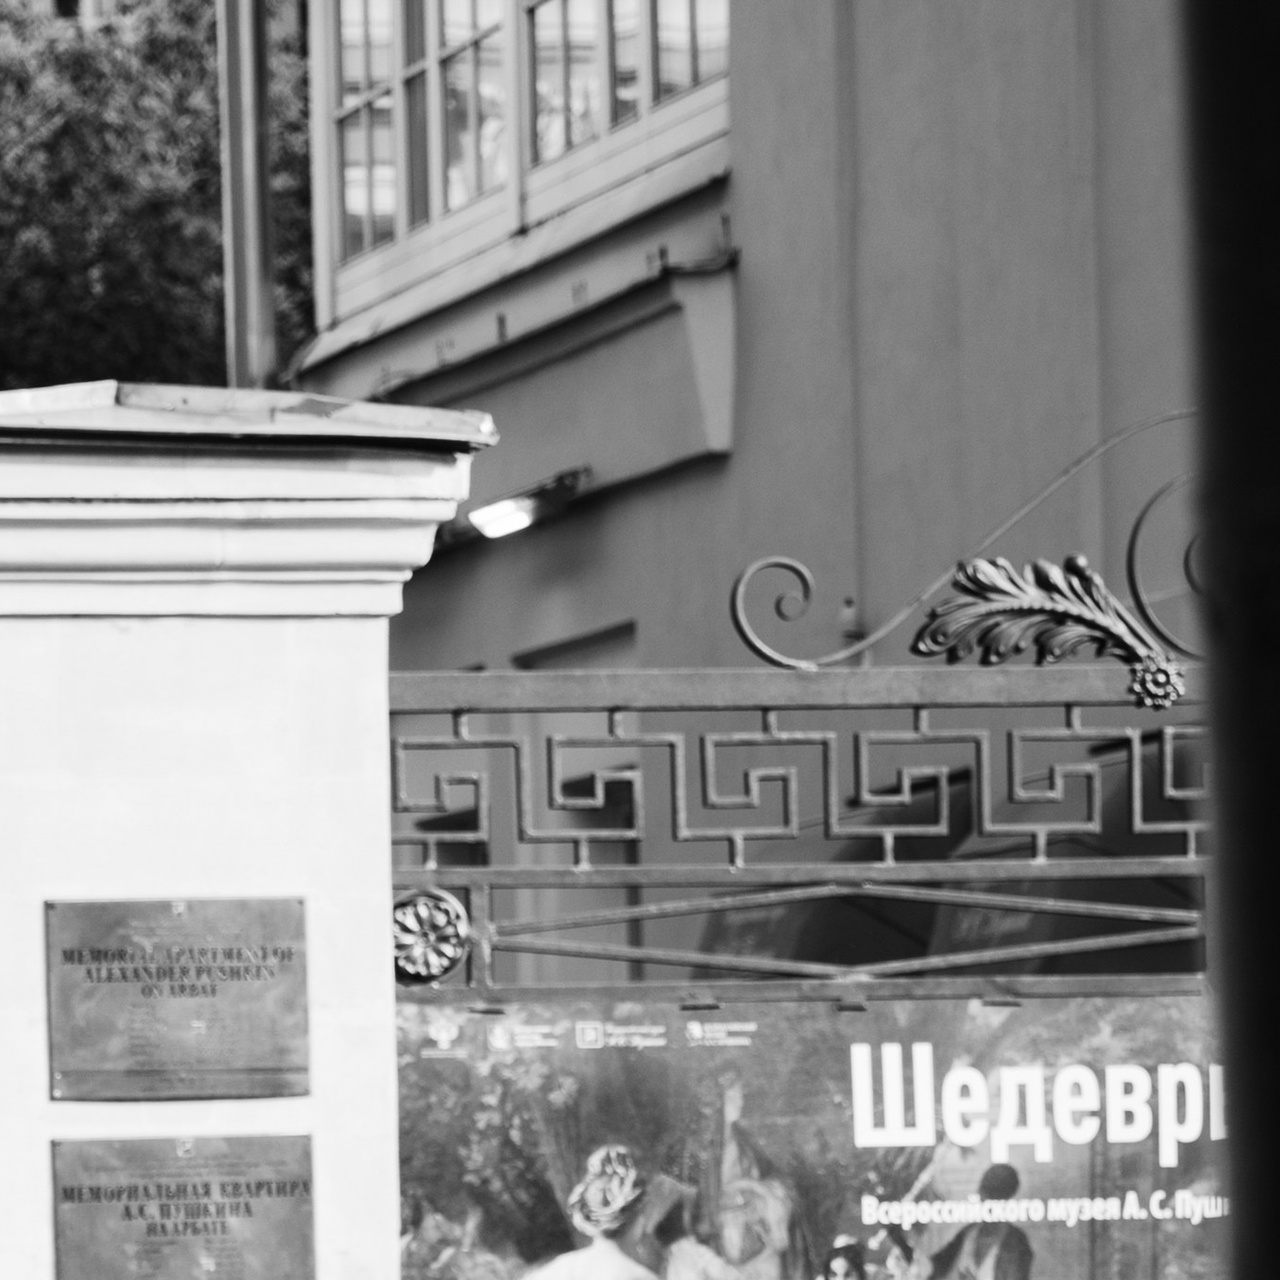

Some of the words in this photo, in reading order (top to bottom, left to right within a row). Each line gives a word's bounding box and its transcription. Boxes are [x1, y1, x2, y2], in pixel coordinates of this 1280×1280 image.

[861, 1194, 1045, 1230] Всероссийского
[1048, 1196, 1120, 1227] музея
[1175, 1189, 1229, 1226] Пуш
